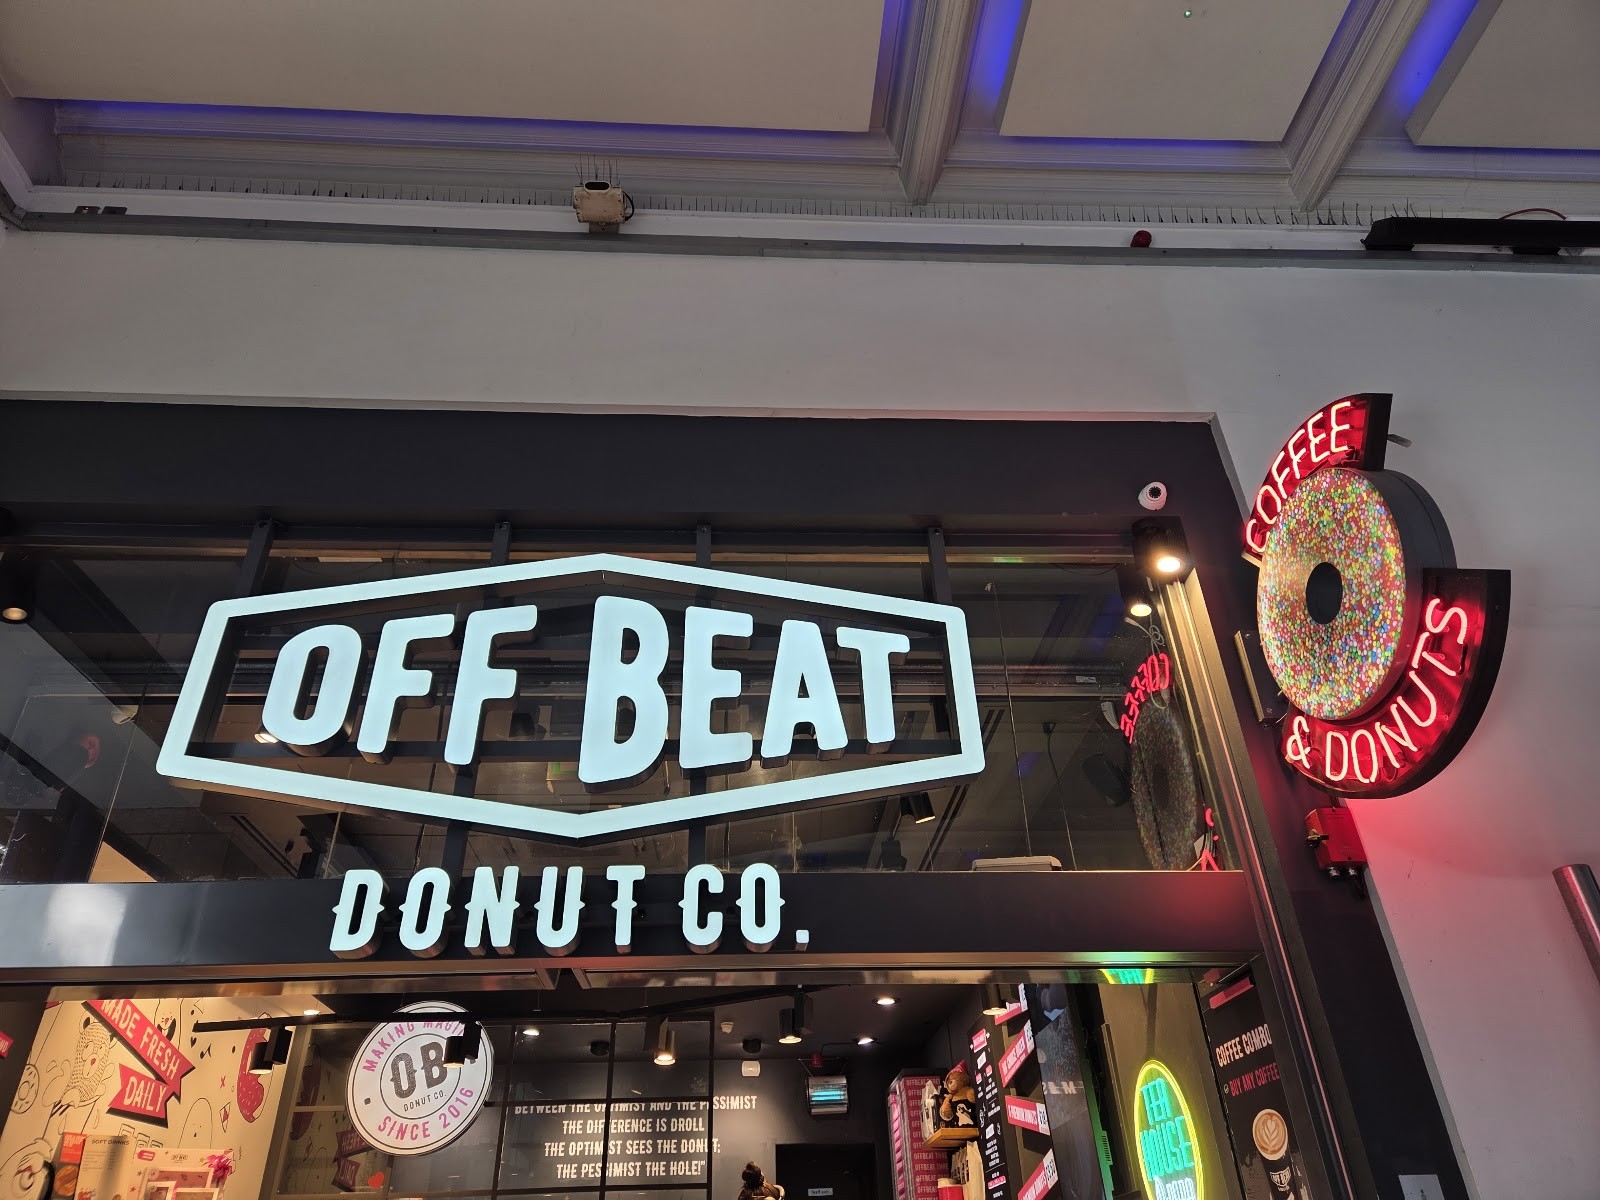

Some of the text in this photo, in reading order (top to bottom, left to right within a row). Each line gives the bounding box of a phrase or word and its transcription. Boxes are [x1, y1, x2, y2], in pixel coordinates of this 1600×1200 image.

[1246, 401, 1351, 553] COFFEE
[261, 596, 910, 783] OFF BEAT
[1286, 597, 1468, 783] & DONUTS
[329, 862, 809, 953] DONUT CO.
[101, 998, 180, 1081] MADE FRESH
[362, 1021, 415, 1072] MAKING
[1216, 1023, 1273, 1067] COFFEE COMBO
[123, 1076, 167, 1113] DAILY
[390, 1041, 448, 1099] OB
[1229, 1062, 1280, 1097] BUY ANY COFFEE
[378, 1115, 431, 1141] SINCE
[438, 1088, 474, 1130] 2016
[403, 1090, 447, 1112] DONUT CO.
[563, 1117, 705, 1135] THE DIFERENCE IS DROLL
[544, 1142, 566, 1157] THE
[568, 1140, 623, 1156] OPTIMST
[625, 1139, 653, 1155] SEES
[656, 1139, 678, 1154] THE
[556, 1164, 578, 1179] THE
[645, 1162, 667, 1177] THE
